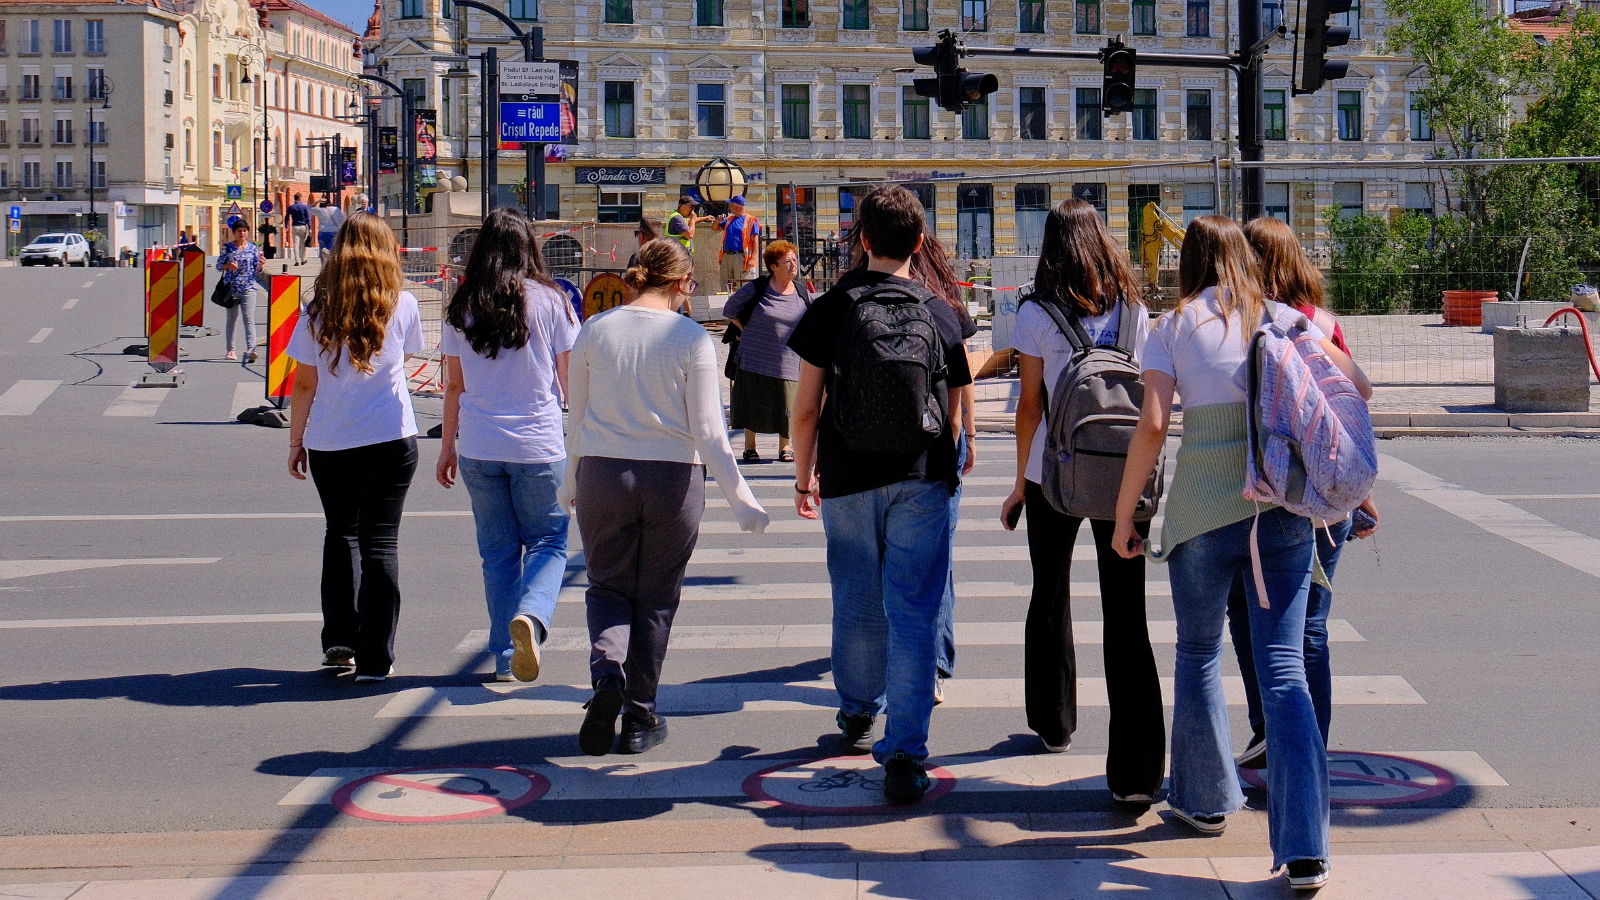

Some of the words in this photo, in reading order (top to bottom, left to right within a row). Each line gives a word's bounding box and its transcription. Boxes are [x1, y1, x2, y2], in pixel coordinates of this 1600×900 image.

[528, 122, 559, 140] Repede
[587, 168, 627, 183] Sanda
[628, 167, 658, 183] Stil
